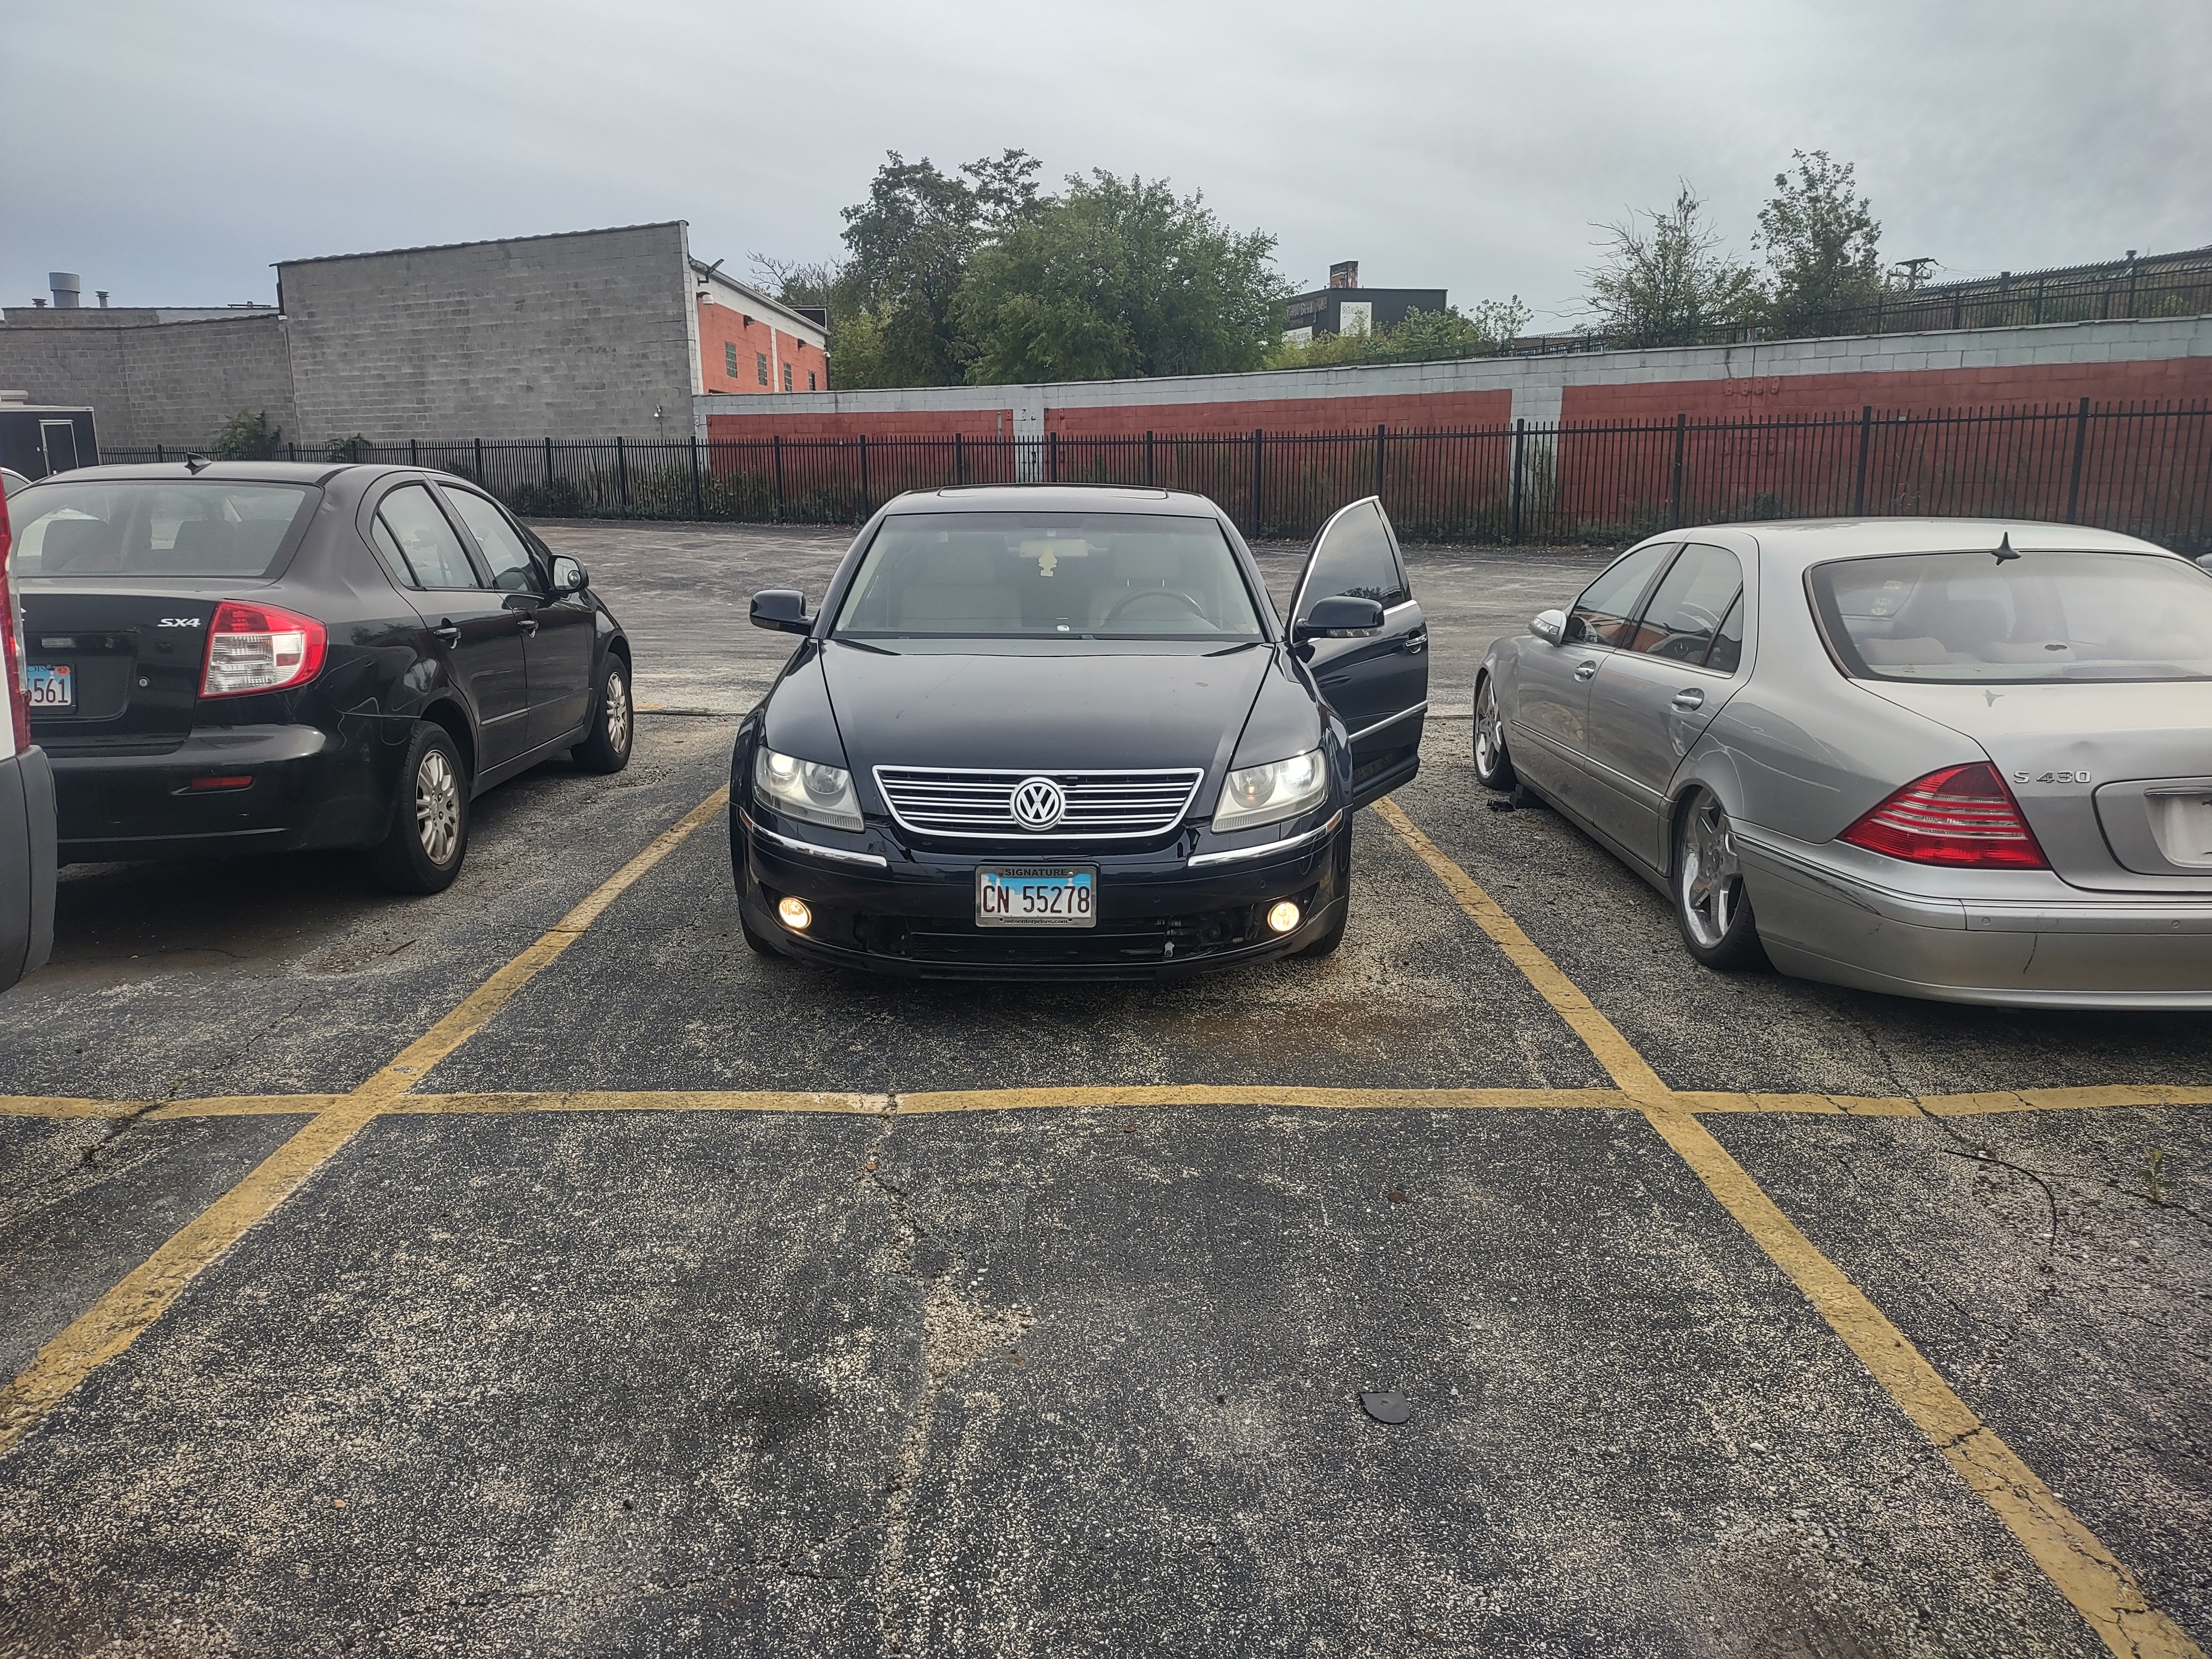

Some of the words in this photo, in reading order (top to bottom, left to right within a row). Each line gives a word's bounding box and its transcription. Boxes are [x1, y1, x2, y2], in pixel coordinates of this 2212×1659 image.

[156, 618, 201, 627] SX4
[2013, 771, 2030, 783] S
[2036, 770, 2091, 783] 430
[983, 885, 1009, 913] CN
[1023, 885, 1090, 913] 55278
